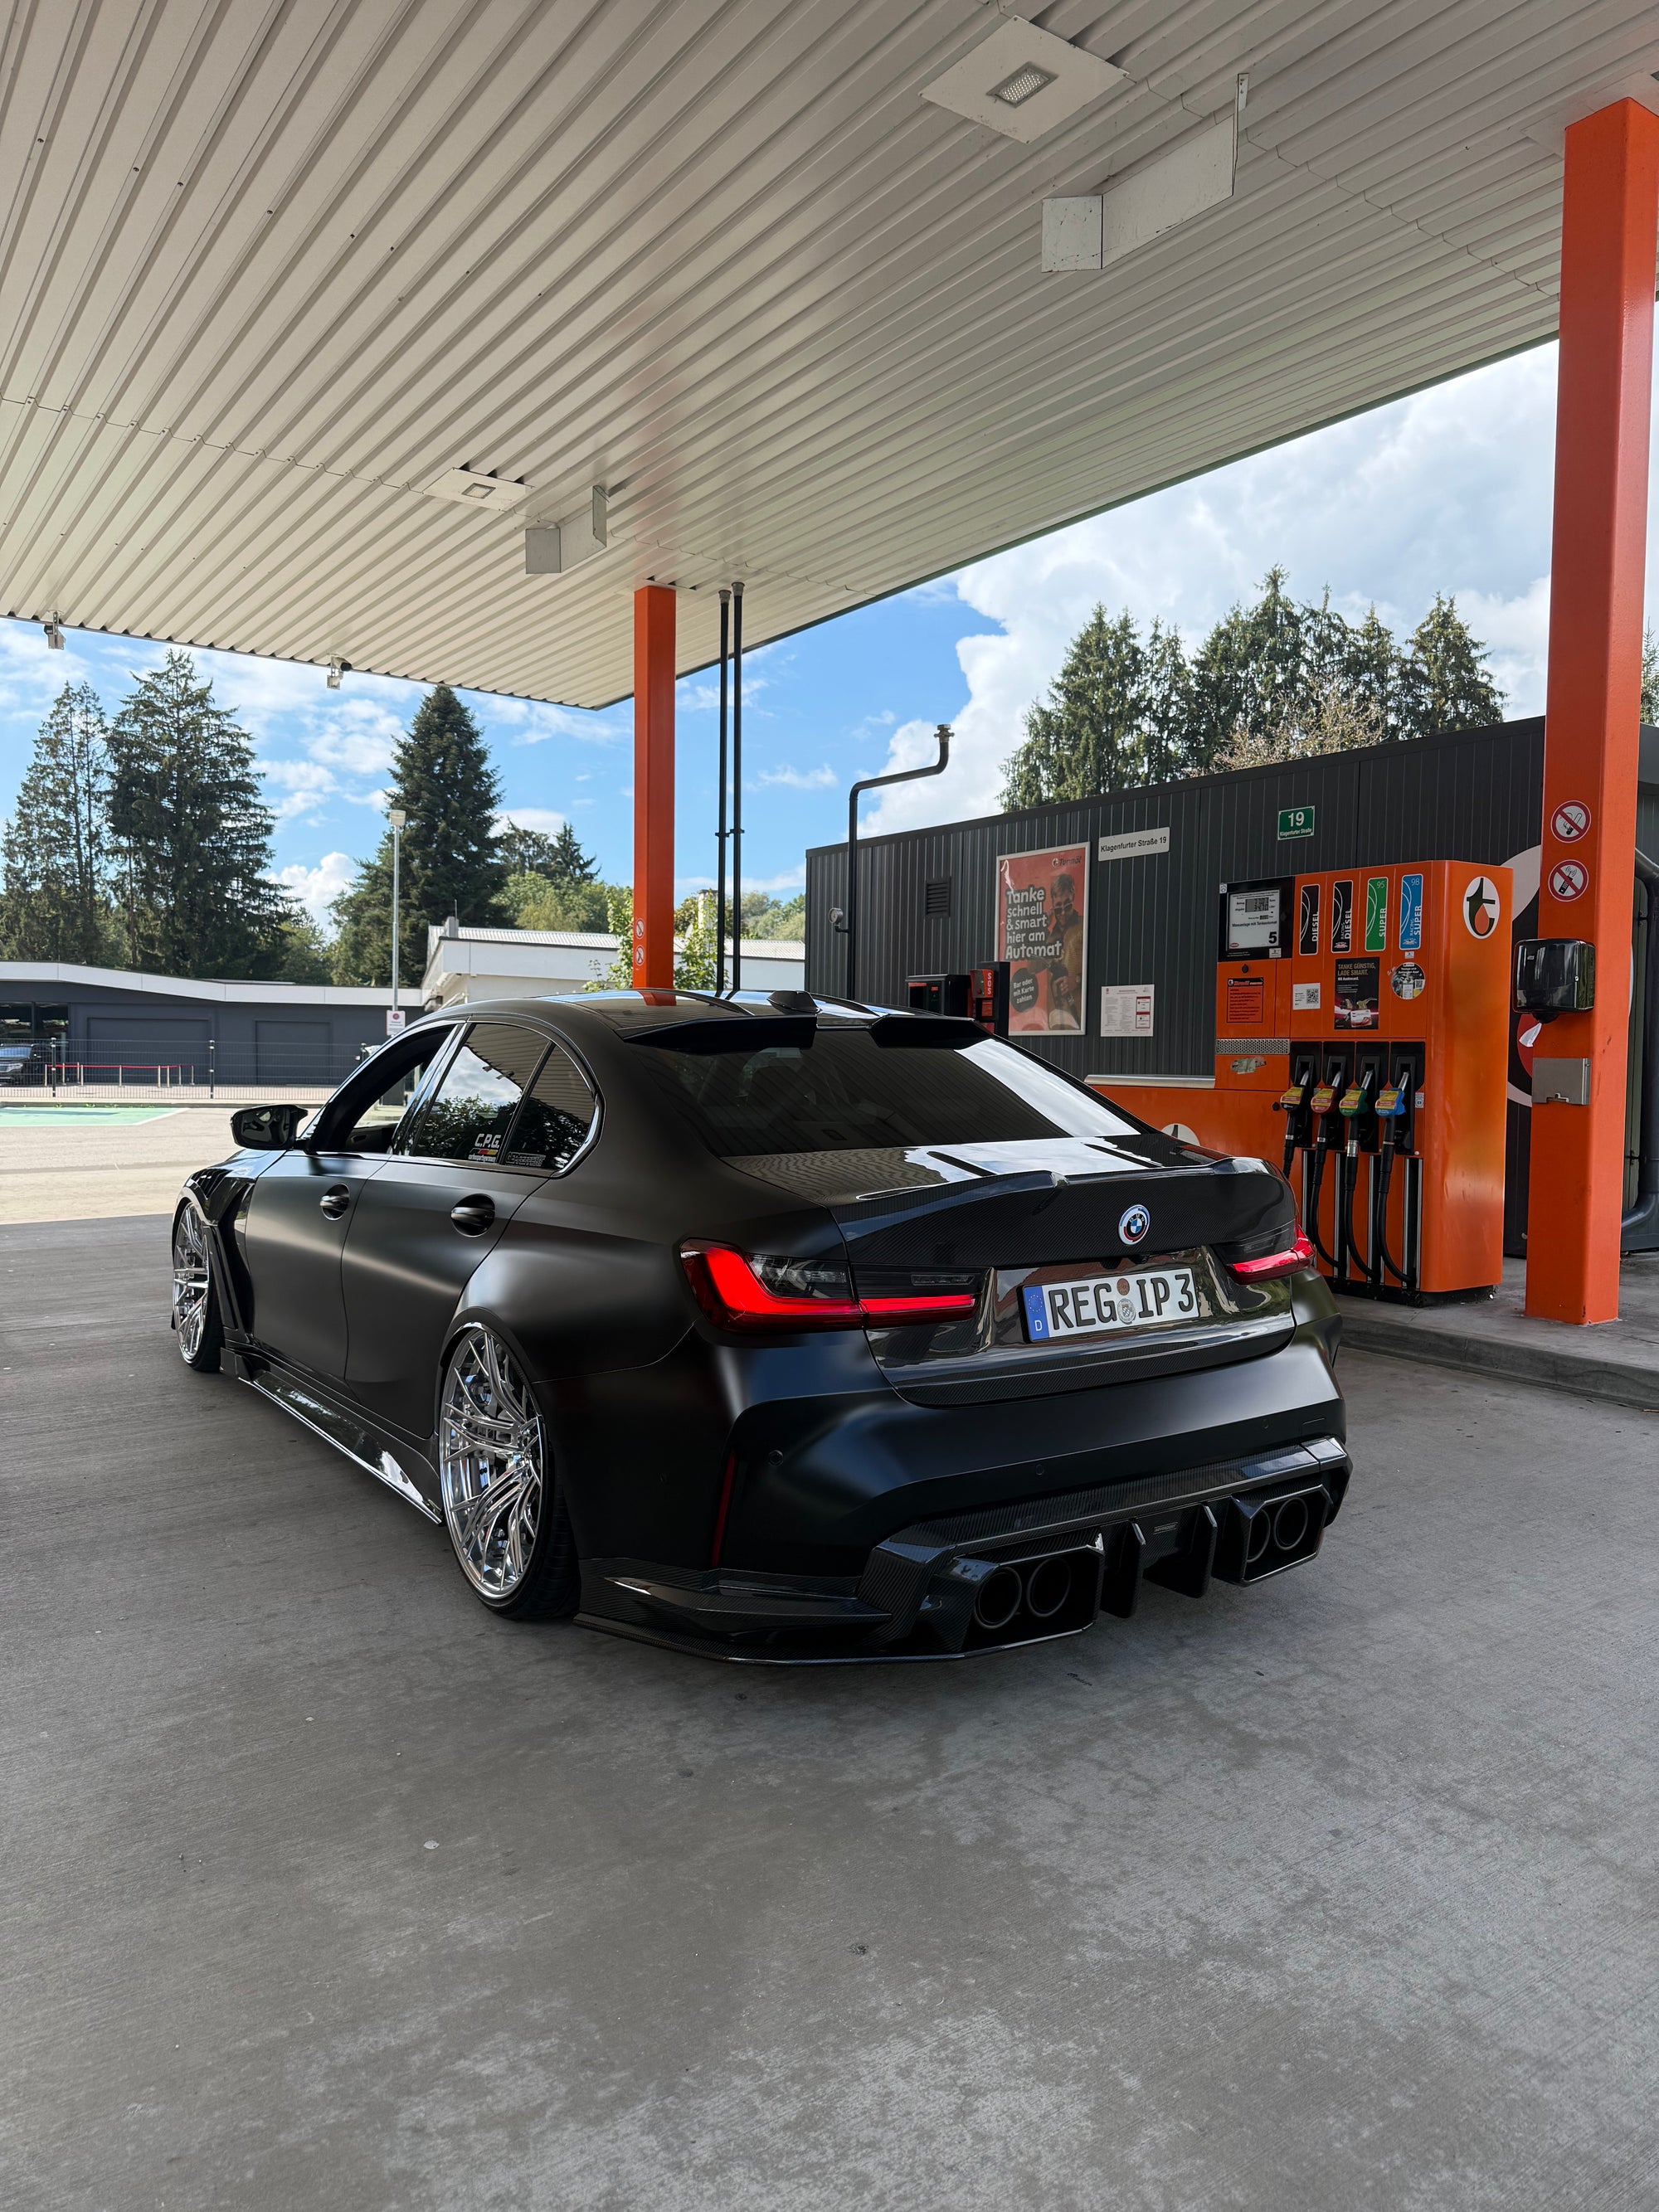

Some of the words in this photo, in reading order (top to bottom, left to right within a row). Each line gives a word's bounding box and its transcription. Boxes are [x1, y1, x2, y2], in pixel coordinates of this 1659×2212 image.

[1288, 811, 1305, 827] 19
[1100, 841, 1136, 853] Klagenfurter
[1137, 838, 1158, 847] Straße
[1377, 880, 1385, 889] 95
[1411, 878, 1420, 887] 98
[1006, 887, 1045, 905] Tanke
[1007, 902, 1043, 918] schnell
[1014, 914, 1048, 931] smart
[1379, 907, 1387, 937] SUPER
[1413, 905, 1422, 936] SUPER
[1006, 931, 1026, 944] hier
[1029, 931, 1045, 941] am
[1268, 931, 1277, 944] 5
[1005, 940, 1062, 960] Automat
[1021, 985, 1035, 994] Karte
[1022, 978, 1034, 986] oder
[1016, 994, 1034, 1004] zahlen
[474, 1133, 502, 1148] C.P.G.
[1129, 1213, 1146, 1223] BMW
[1034, 1320, 1044, 1332] D
[1048, 1282, 1117, 1330] REG
[1136, 1276, 1170, 1319] IP
[1175, 1273, 1194, 1313] 3
